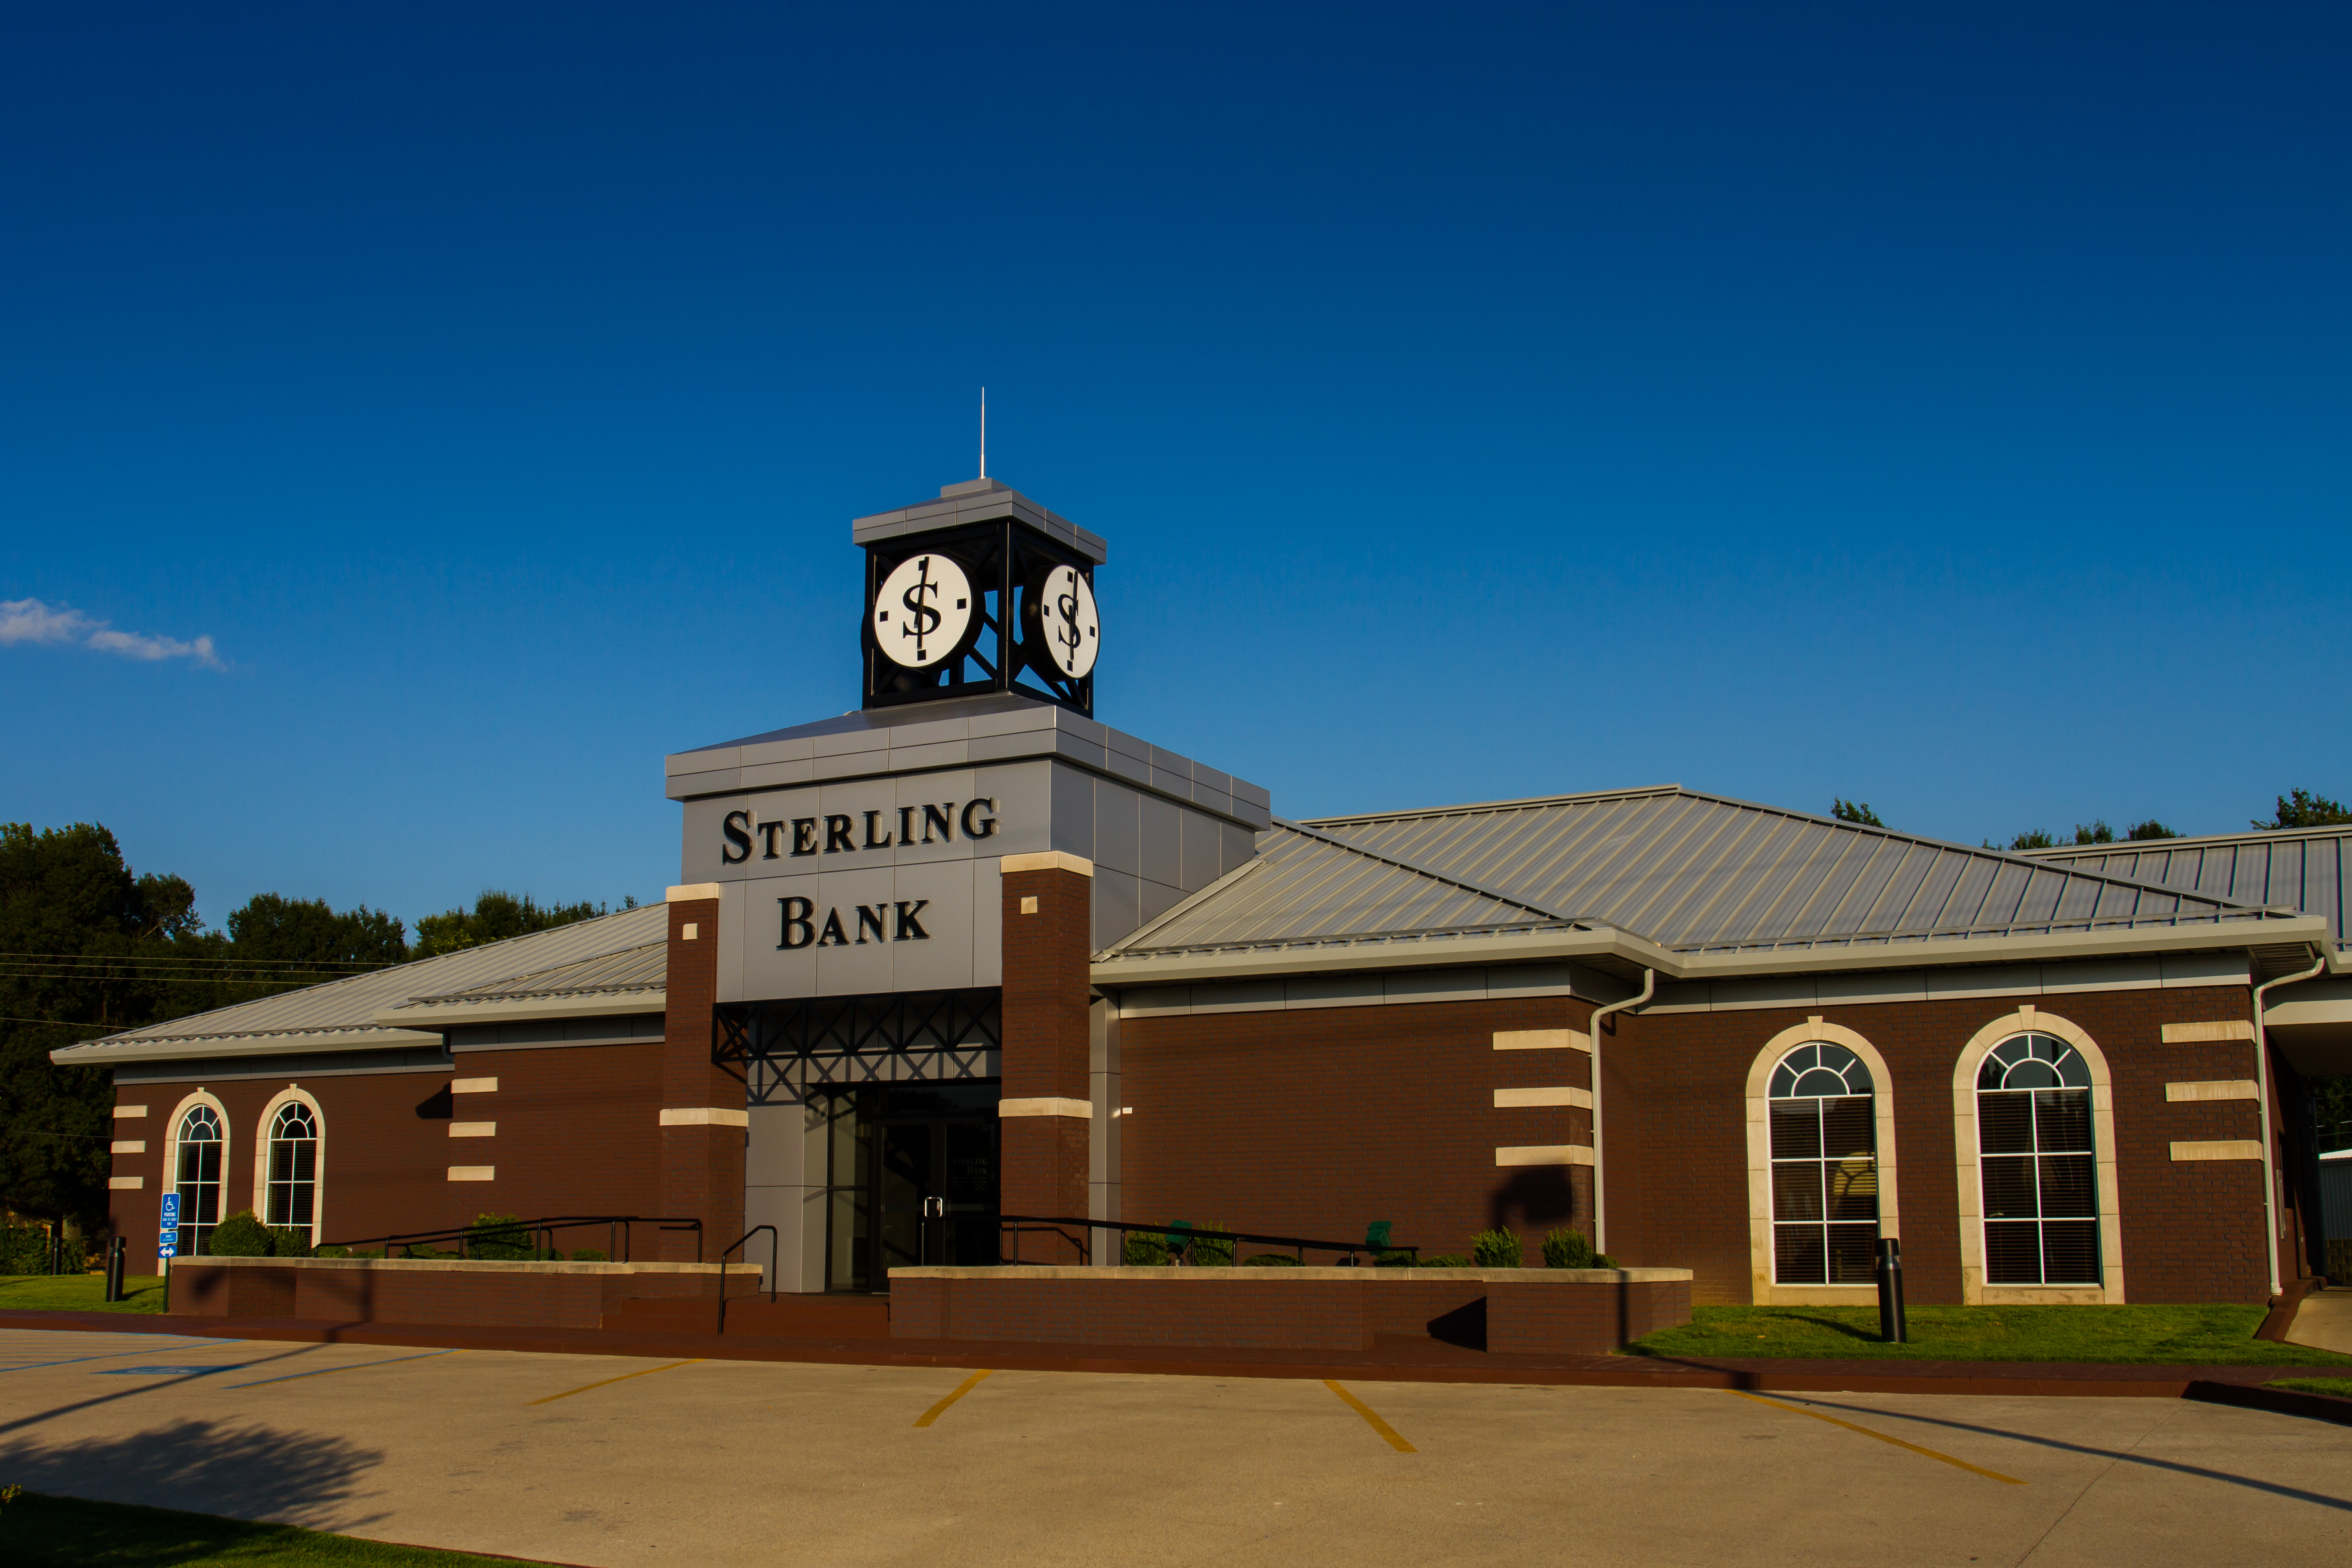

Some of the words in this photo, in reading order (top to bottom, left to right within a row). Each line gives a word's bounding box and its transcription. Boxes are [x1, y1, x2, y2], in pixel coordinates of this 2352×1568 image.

[722, 797, 997, 864] STERLING
[776, 896, 929, 950] BANK
[952, 1157, 988, 1166] STERLING
[967, 1166, 988, 1175] BANK
